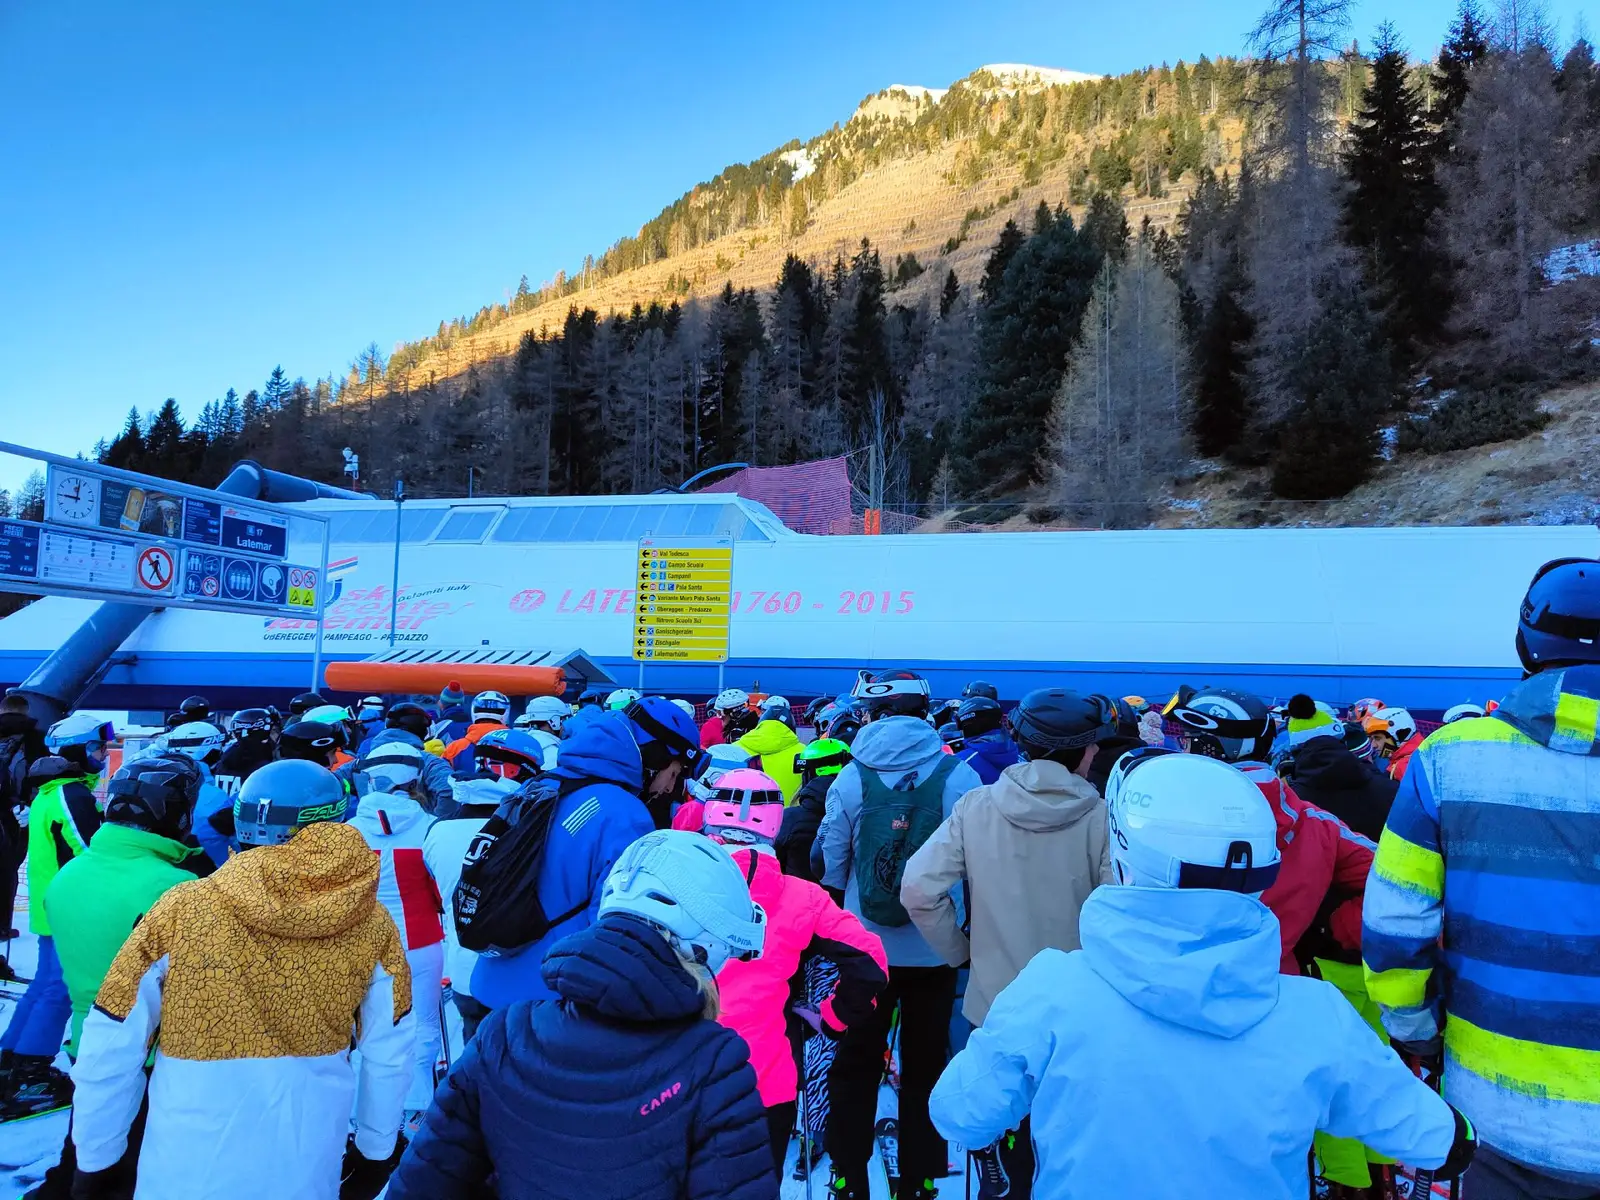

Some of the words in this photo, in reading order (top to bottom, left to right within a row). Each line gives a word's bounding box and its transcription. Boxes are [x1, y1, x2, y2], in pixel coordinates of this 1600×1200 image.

[236, 536, 273, 551] Latemar
[556, 589, 637, 613] LATE
[731, 590, 803, 614] 1760
[837, 590, 915, 614] 2015
[263, 632, 317, 641] OBEREGGEN
[323, 633, 372, 642] PAMPEAGO
[380, 633, 429, 642] PREDAZZO
[727, 933, 753, 947] ALPINA
[639, 1081, 682, 1116] CAMP
